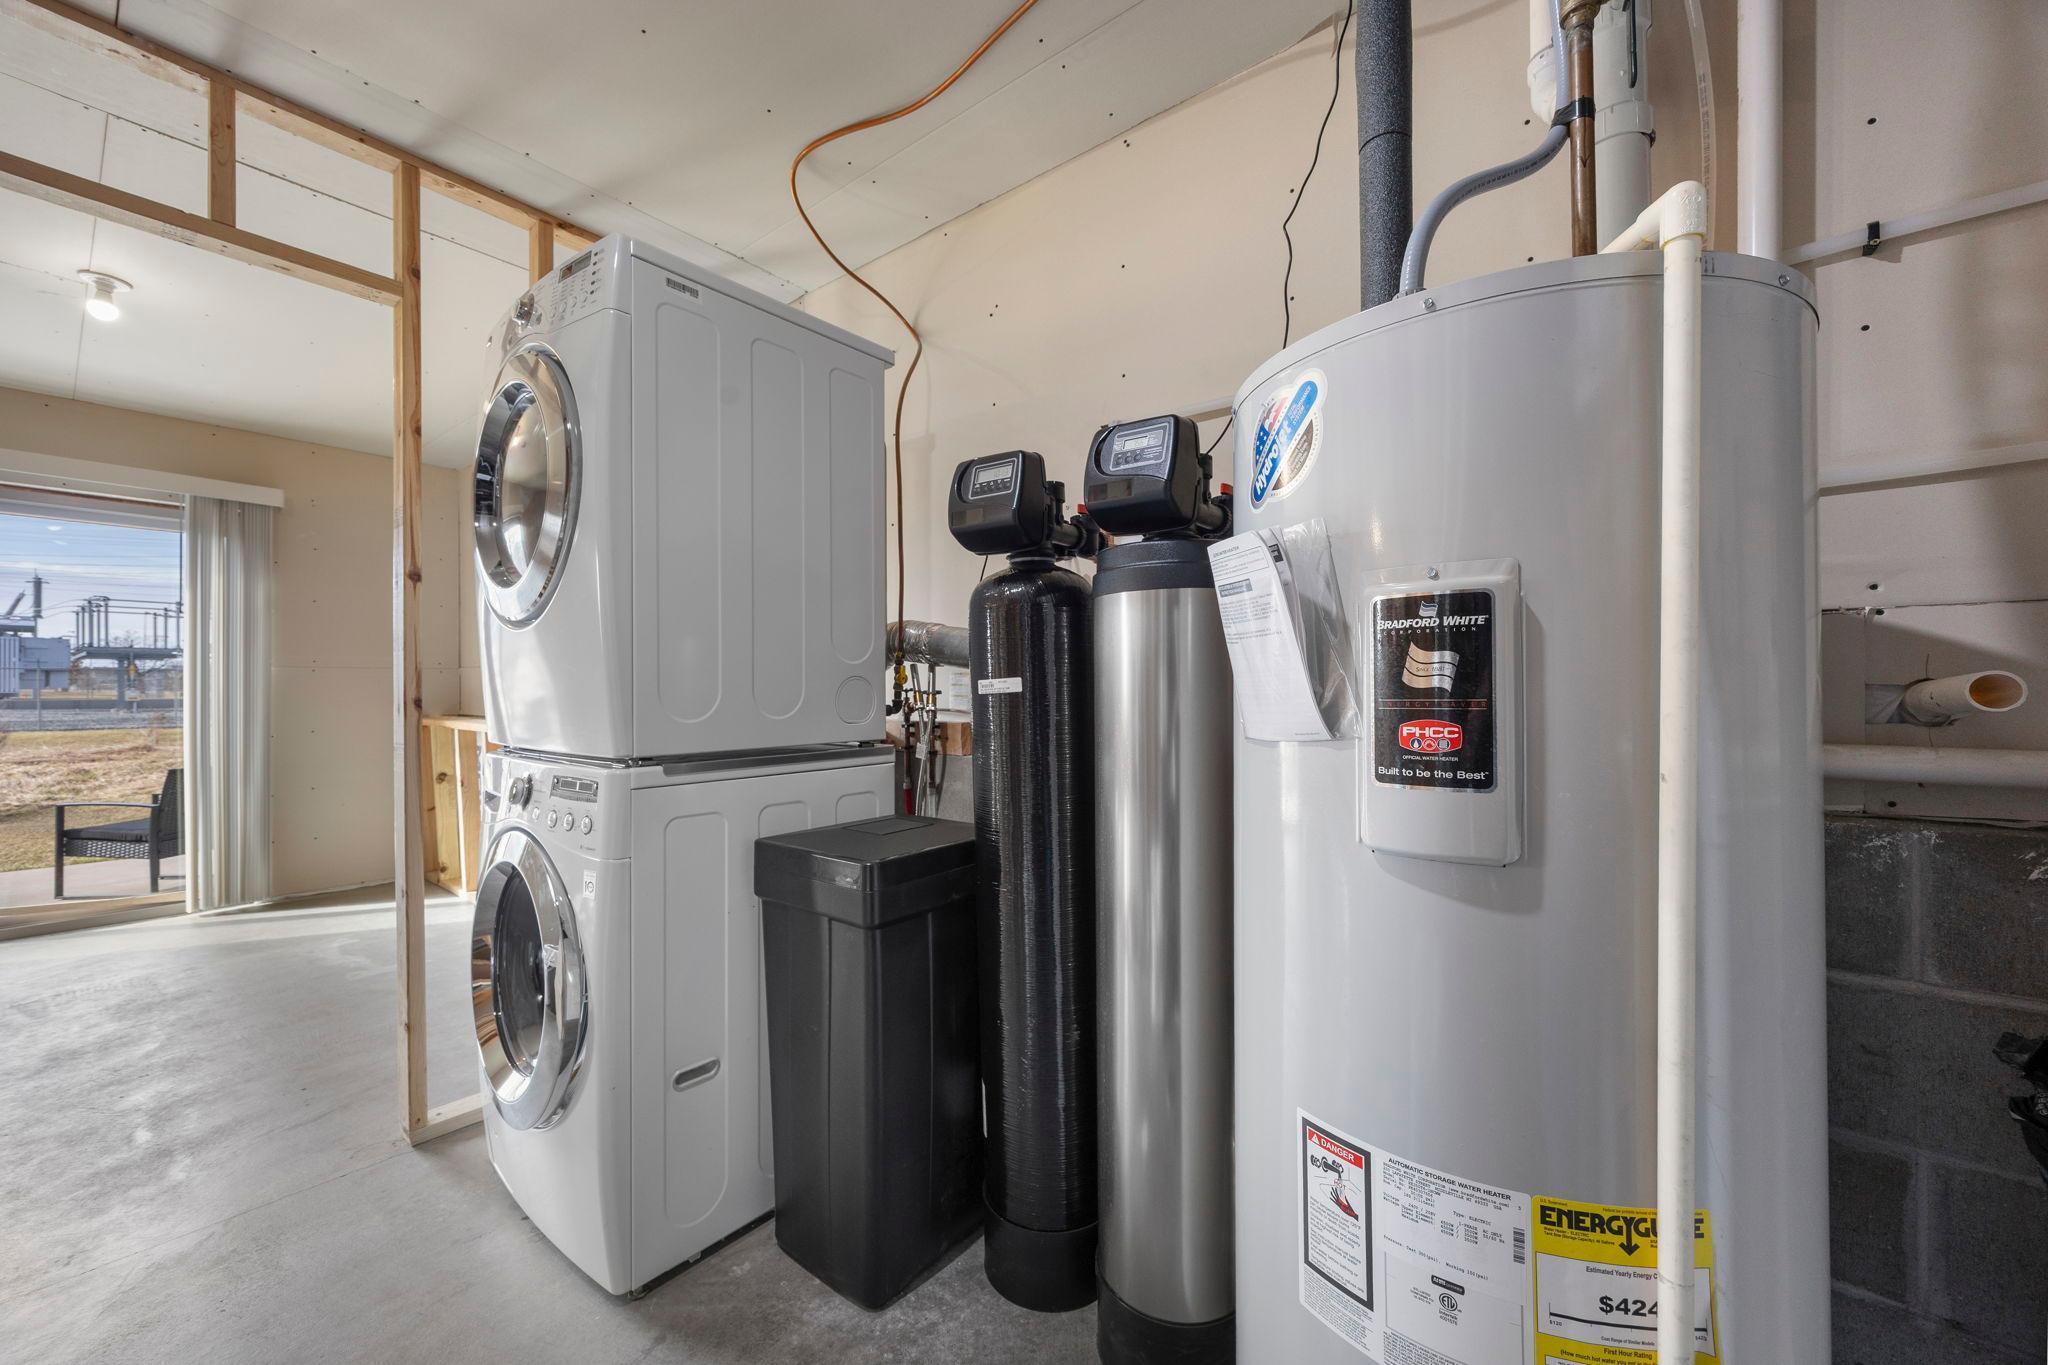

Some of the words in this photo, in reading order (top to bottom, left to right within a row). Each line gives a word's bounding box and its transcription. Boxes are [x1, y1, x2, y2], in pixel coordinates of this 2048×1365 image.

[1377, 618, 1440, 630] BRADFORD
[1443, 615, 1486, 626] WHITE
[1384, 626, 1476, 636] CORPORATION
[1402, 726, 1459, 738] PHCC
[1378, 766, 1400, 776] Built
[1402, 768, 1414, 776] to
[1416, 768, 1430, 778] be
[1434, 770, 1454, 779] the
[1457, 770, 1486, 780] Best
[1321, 1139, 1355, 1162] DANGER
[1388, 1158, 1424, 1174] AUTOMATIC
[1424, 1171, 1456, 1186] STORAGE
[1458, 1182, 1482, 1194] WATER
[1483, 1189, 1512, 1200] HEATER
[1540, 1205, 1704, 1240] ENERGYGE
[1586, 1266, 1614, 1276] Estimated
[1615, 1270, 1632, 1278] Yearly
[1633, 1272, 1652, 1280] Energy
[1442, 1295, 1456, 1310] ETL
[1560, 1350, 1574, 1358] (How
[1604, 1348, 1618, 1356] First
[1634, 1352, 1652, 1360] Rating
